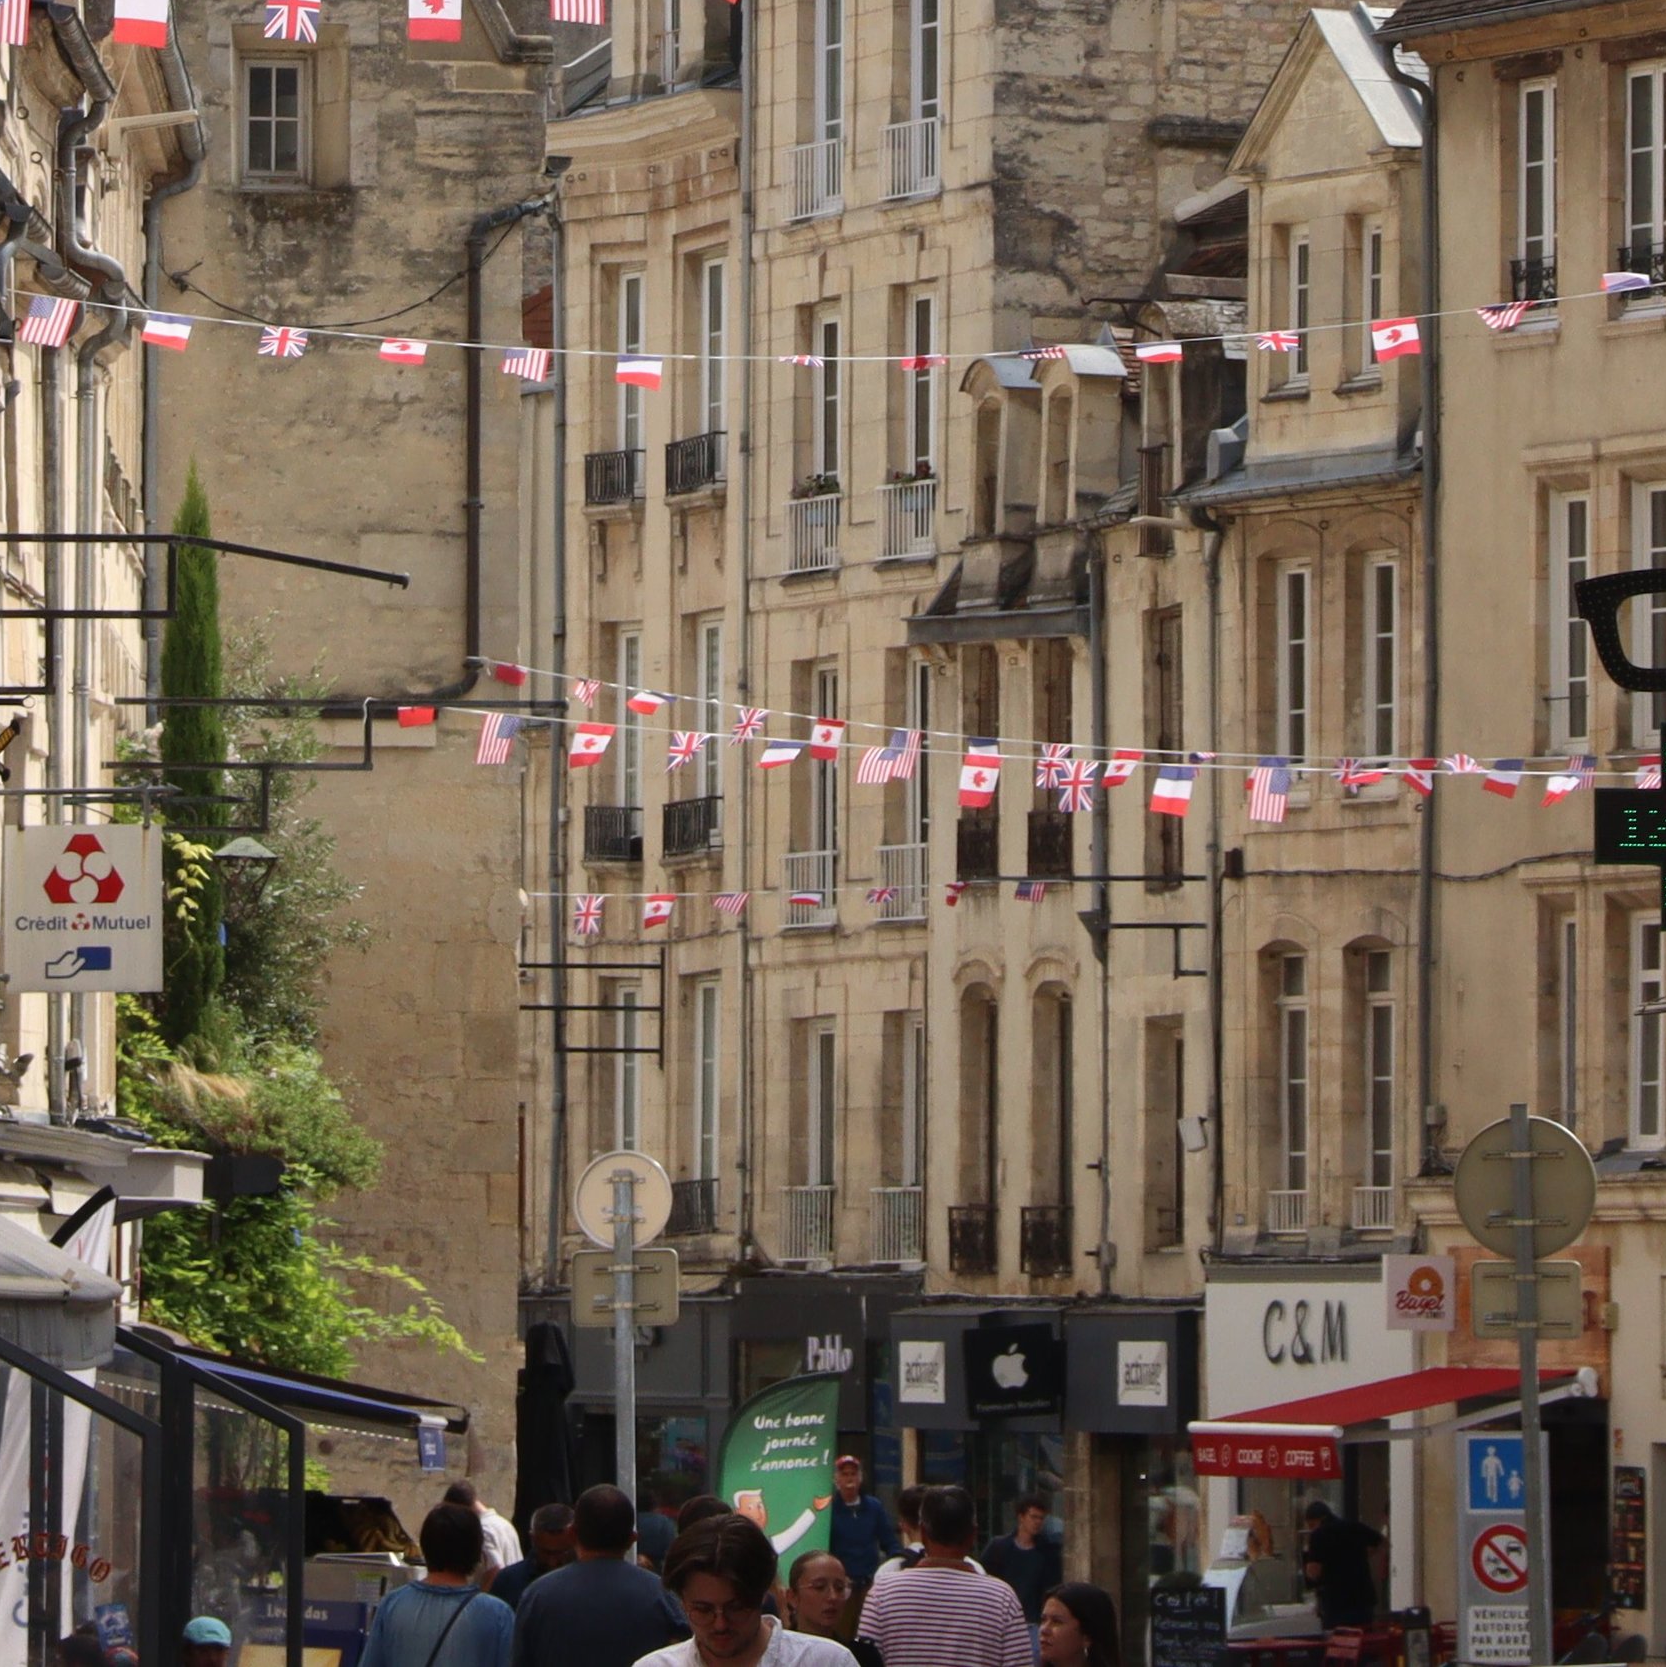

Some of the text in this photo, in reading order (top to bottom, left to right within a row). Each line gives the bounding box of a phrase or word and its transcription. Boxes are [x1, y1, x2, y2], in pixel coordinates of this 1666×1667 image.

[15, 915, 151, 931] Crédit Mutuel
[1395, 1290, 1445, 1317] Bagel
[807, 1334, 854, 1373] Pablo
[754, 1412, 826, 1430] Une bonne
[763, 1431, 818, 1455] journée
[750, 1456, 819, 1472] s'annonce
[1472, 1635, 1493, 1645] PAR
